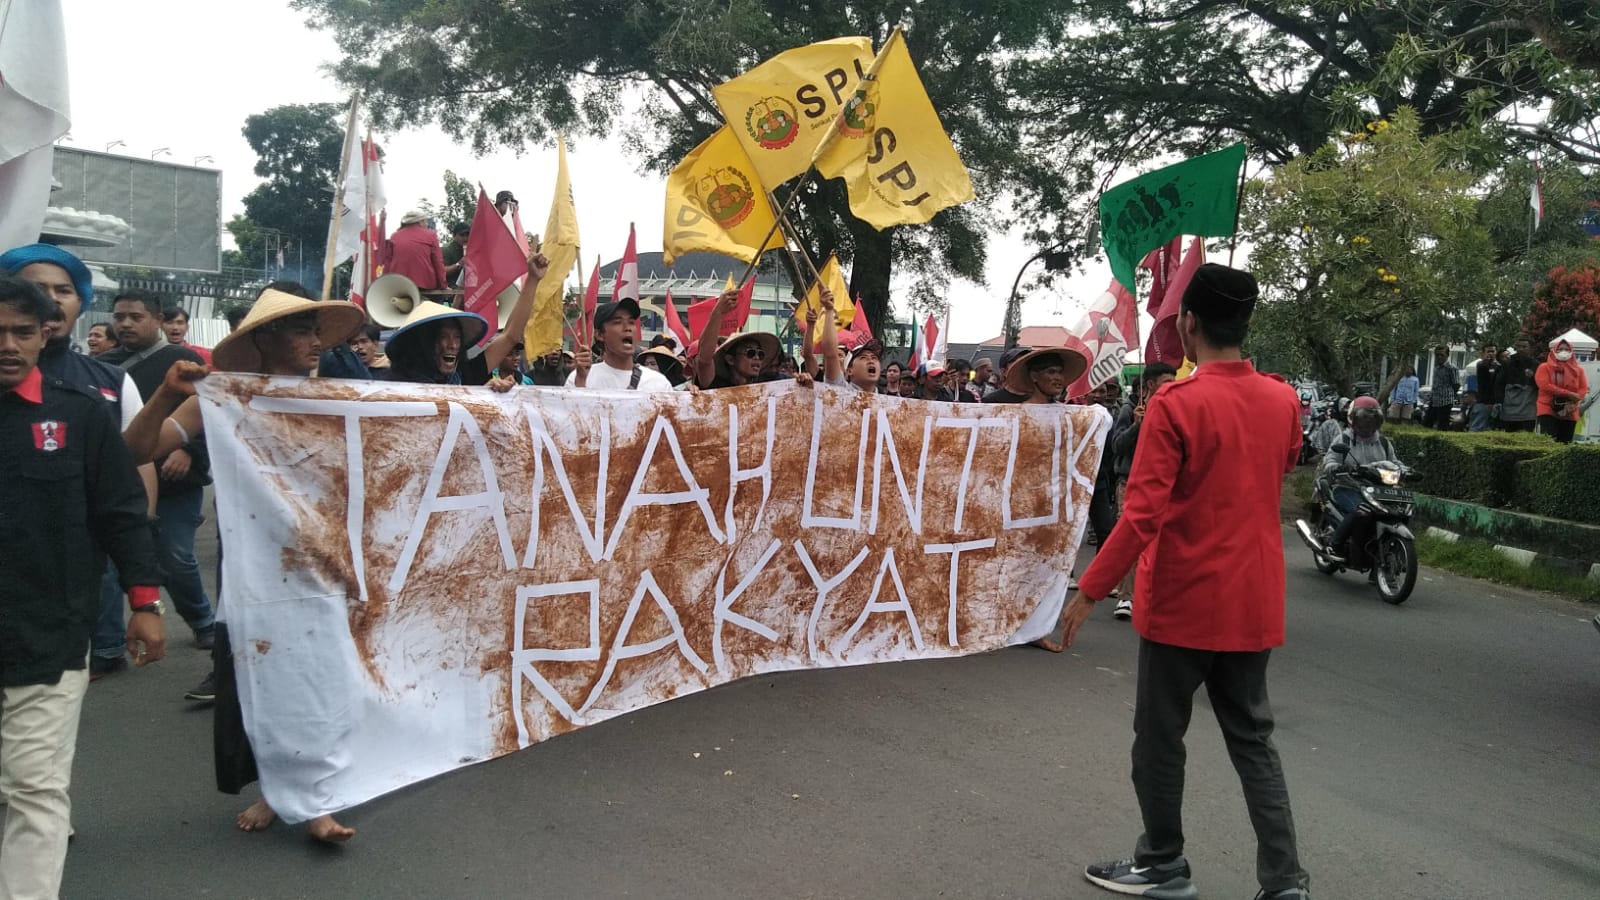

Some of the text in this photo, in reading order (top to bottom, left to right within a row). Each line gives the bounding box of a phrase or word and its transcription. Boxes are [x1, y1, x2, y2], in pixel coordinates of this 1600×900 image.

[796, 59, 866, 119] SPI
[867, 127, 930, 206] SPI
[249, 395, 1100, 601] TANAH UNTUK
[511, 538, 996, 749] RAKYAT
